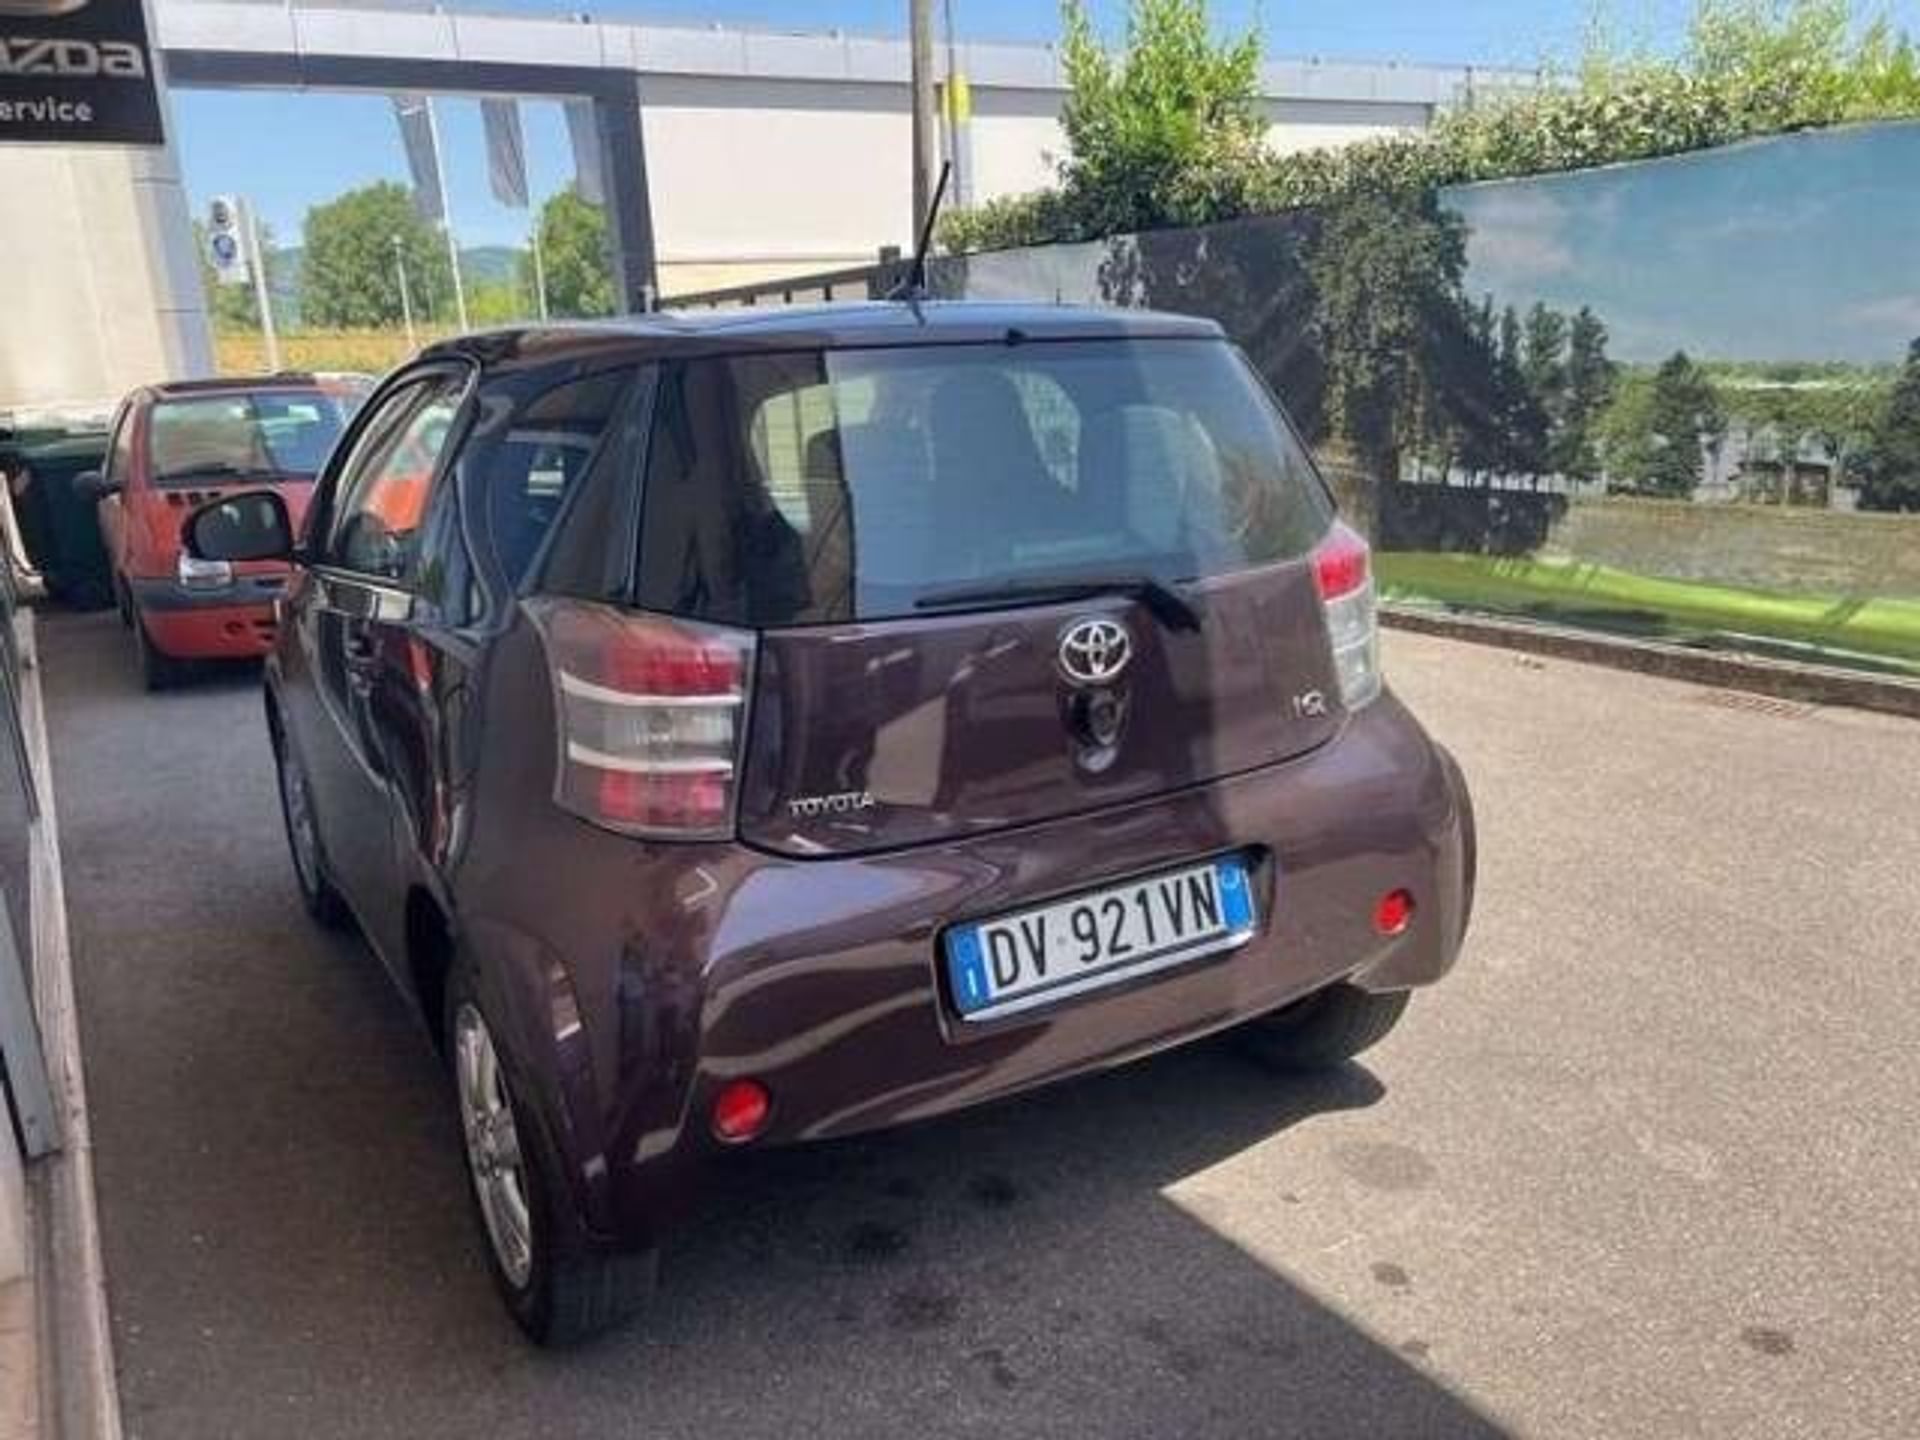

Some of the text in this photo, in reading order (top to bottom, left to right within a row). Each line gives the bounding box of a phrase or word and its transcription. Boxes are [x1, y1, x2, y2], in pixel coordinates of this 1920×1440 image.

[788, 791, 875, 816] TOYOTA
[989, 871, 1221, 989] DV 921VN
